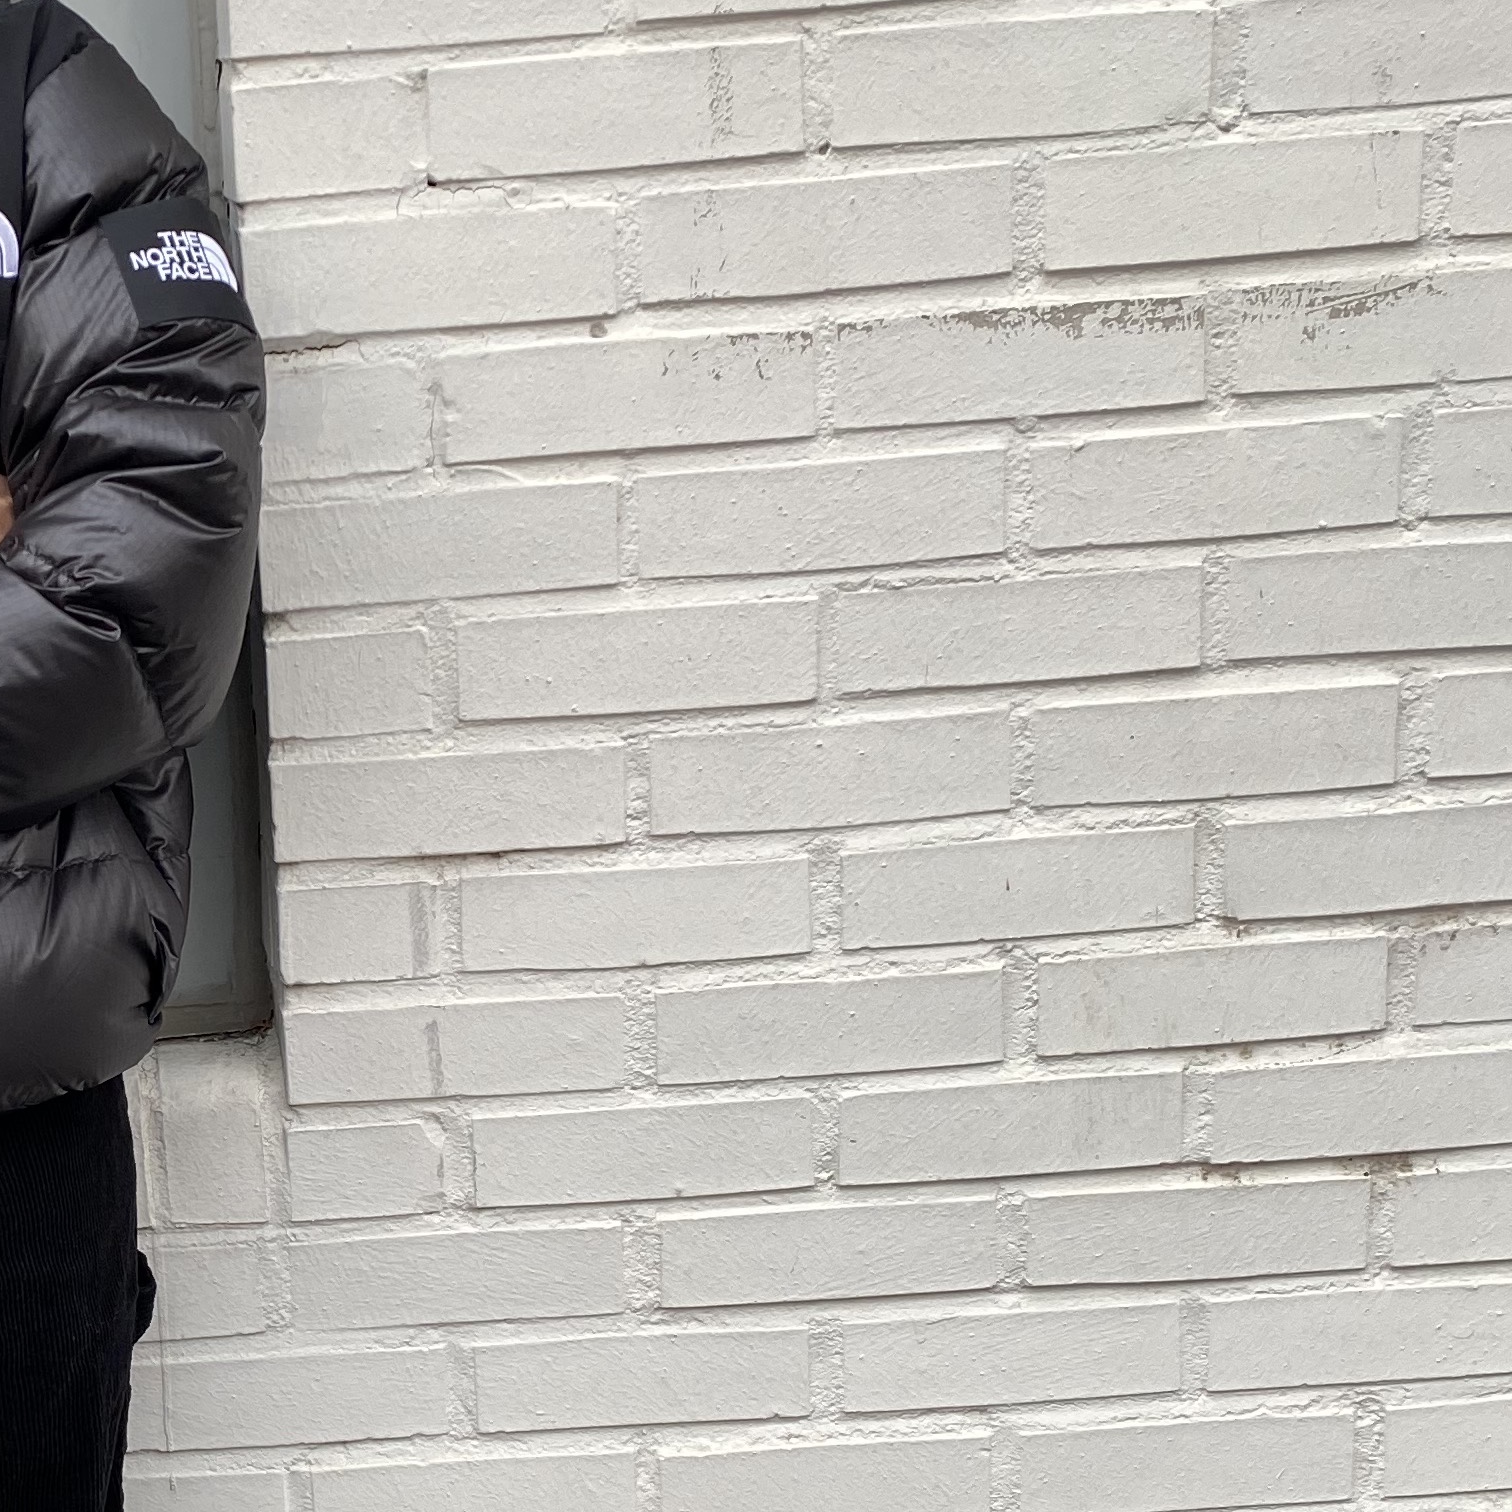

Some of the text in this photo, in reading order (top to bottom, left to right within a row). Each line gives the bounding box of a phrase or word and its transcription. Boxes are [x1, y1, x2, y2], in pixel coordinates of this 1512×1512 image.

[156, 230, 201, 249] THE
[129, 245, 207, 271] NORTH
[157, 262, 213, 281] FACE
